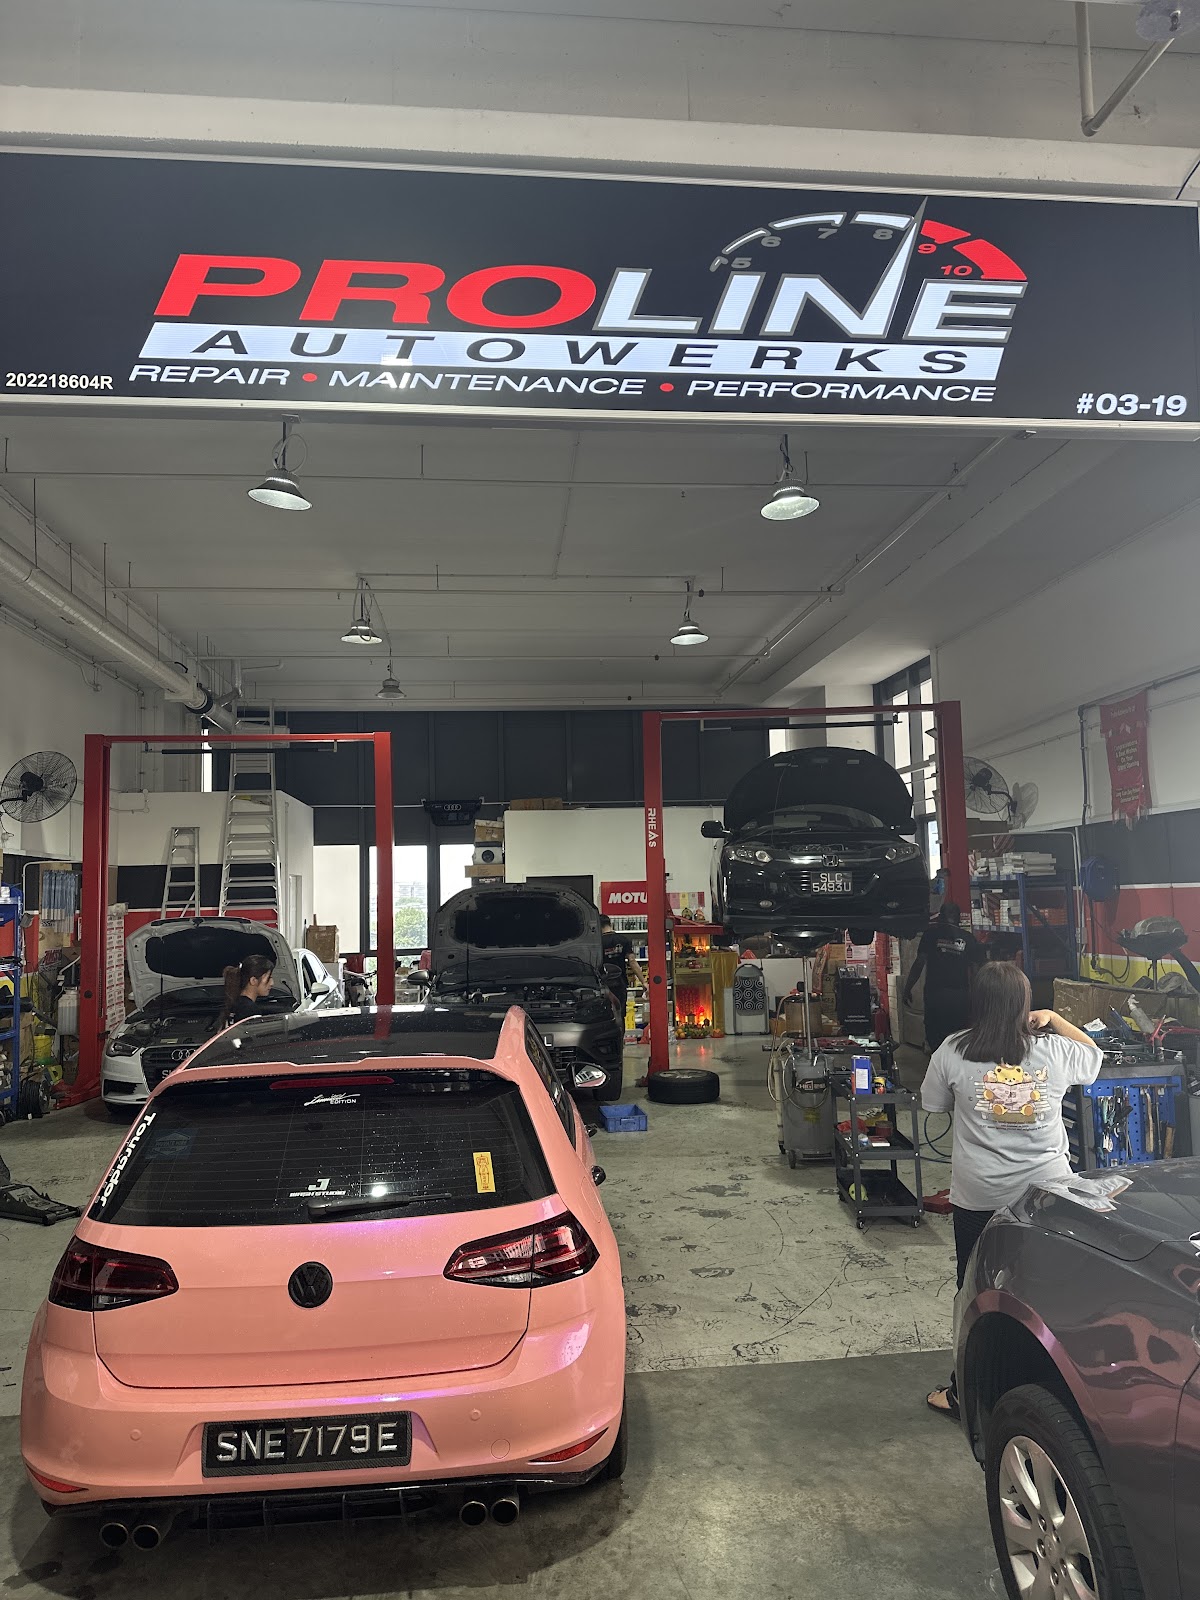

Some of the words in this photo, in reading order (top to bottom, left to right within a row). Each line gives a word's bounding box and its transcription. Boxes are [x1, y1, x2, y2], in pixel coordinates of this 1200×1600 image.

[816, 227, 839, 240] 7
[872, 228, 893, 240] 8
[760, 235, 782, 248] 6
[917, 243, 939, 255] 9
[731, 257, 752, 269] 5
[940, 264, 973, 276] 10
[153, 252, 1028, 342] PROLINE
[191, 329, 968, 374] AUTOWERKS
[5, 371, 114, 391] 202218604R
[128, 363, 291, 386] REPAIR
[328, 369, 646, 397] MAINTENANCE
[686, 378, 997, 403] PERFORMANCE
[1076, 392, 1188, 417] #03-19
[820, 872, 843, 883] SLC
[812, 881, 852, 893] 5493U
[608, 892, 648, 904] MOTU
[100, 1112, 157, 1207] Tourador
